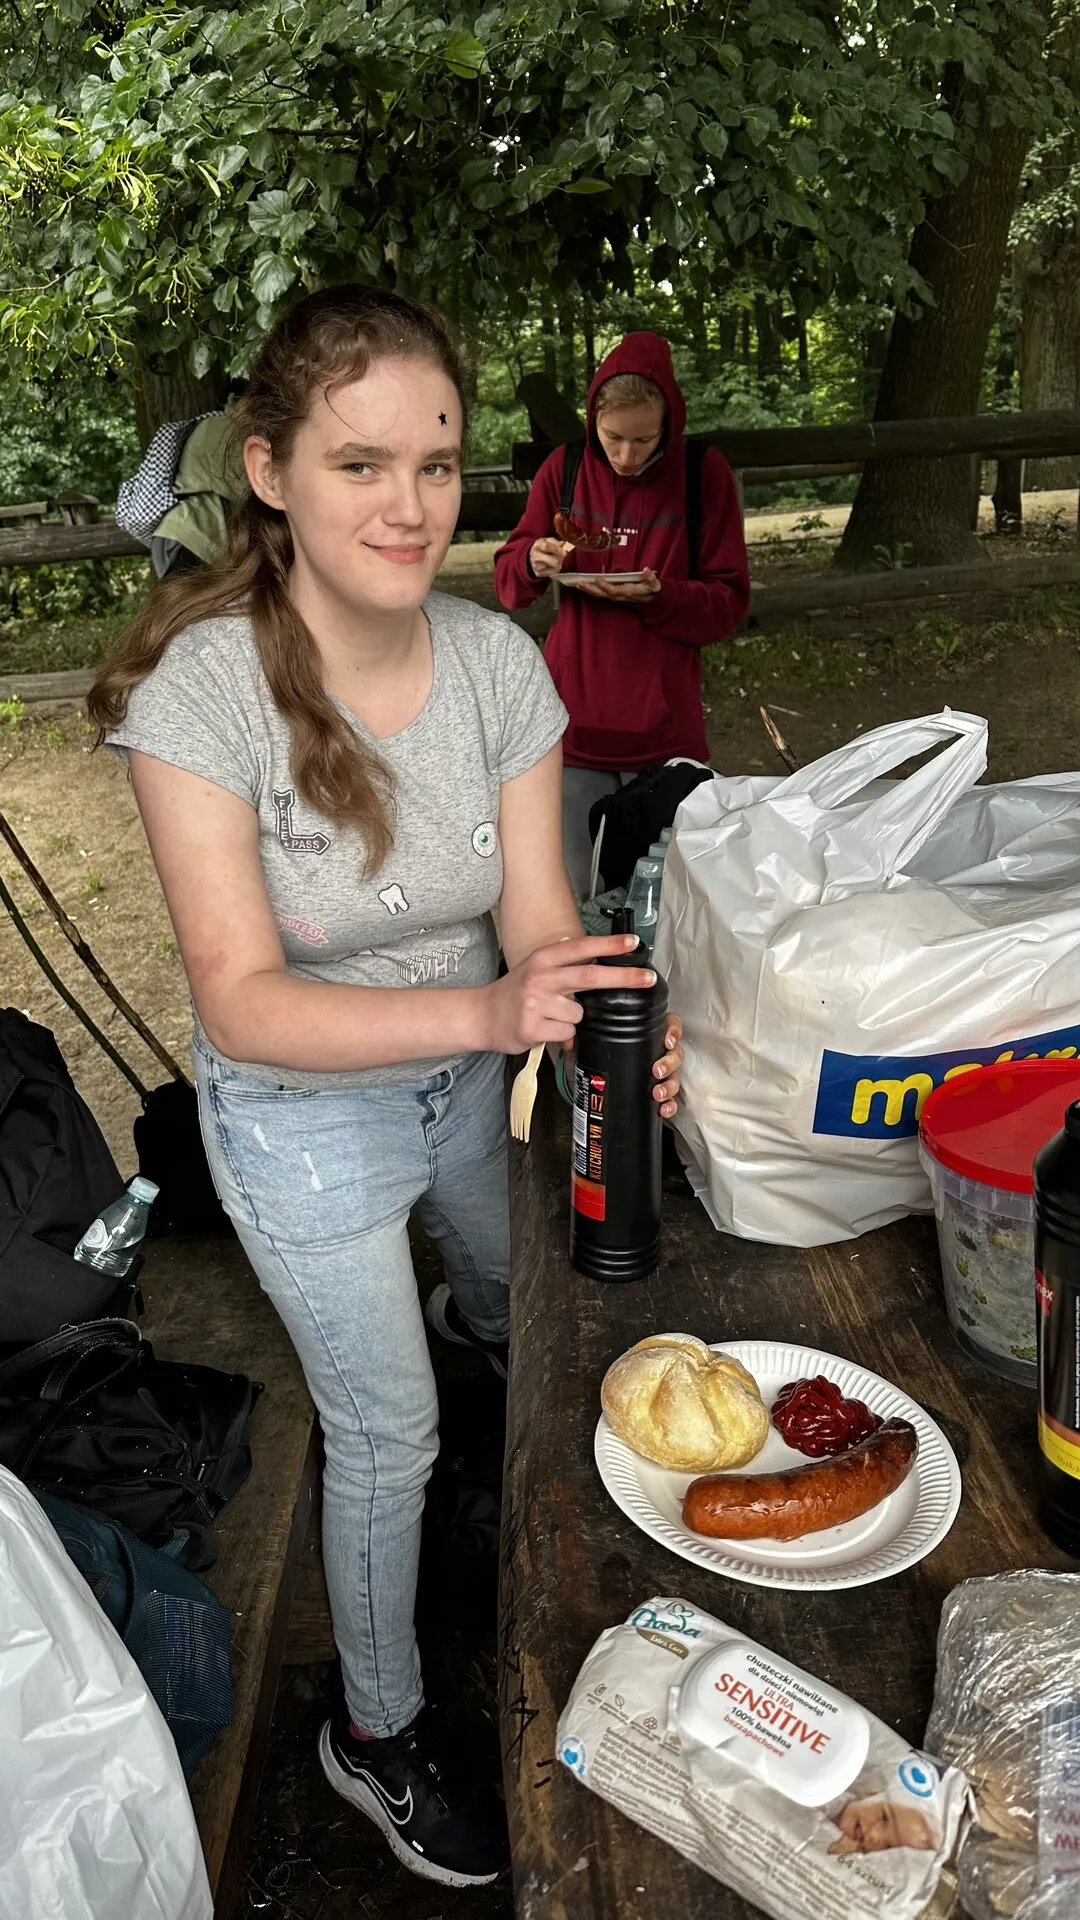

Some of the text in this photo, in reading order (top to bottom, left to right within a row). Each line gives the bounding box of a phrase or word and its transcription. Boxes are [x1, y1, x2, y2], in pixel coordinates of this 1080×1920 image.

[279, 799, 289, 841] FREE
[291, 839, 320, 849] PASS
[401, 946, 466, 984] WHY
[589, 1139, 603, 1180] KETCHUP
[650, 1634, 684, 1654] Extra Care
[746, 1653, 839, 1714] chusteczki nawilżane
[748, 1666, 761, 1677] dla
[760, 1673, 783, 1690] dzieci
[785, 1689, 825, 1717] niemowląt
[764, 1687, 795, 1711] ULTRA
[714, 1673, 831, 1755] SENSITIVE
[731, 1706, 792, 1750] 100% bawełna
[723, 1714, 785, 1758] bezzapachowe
